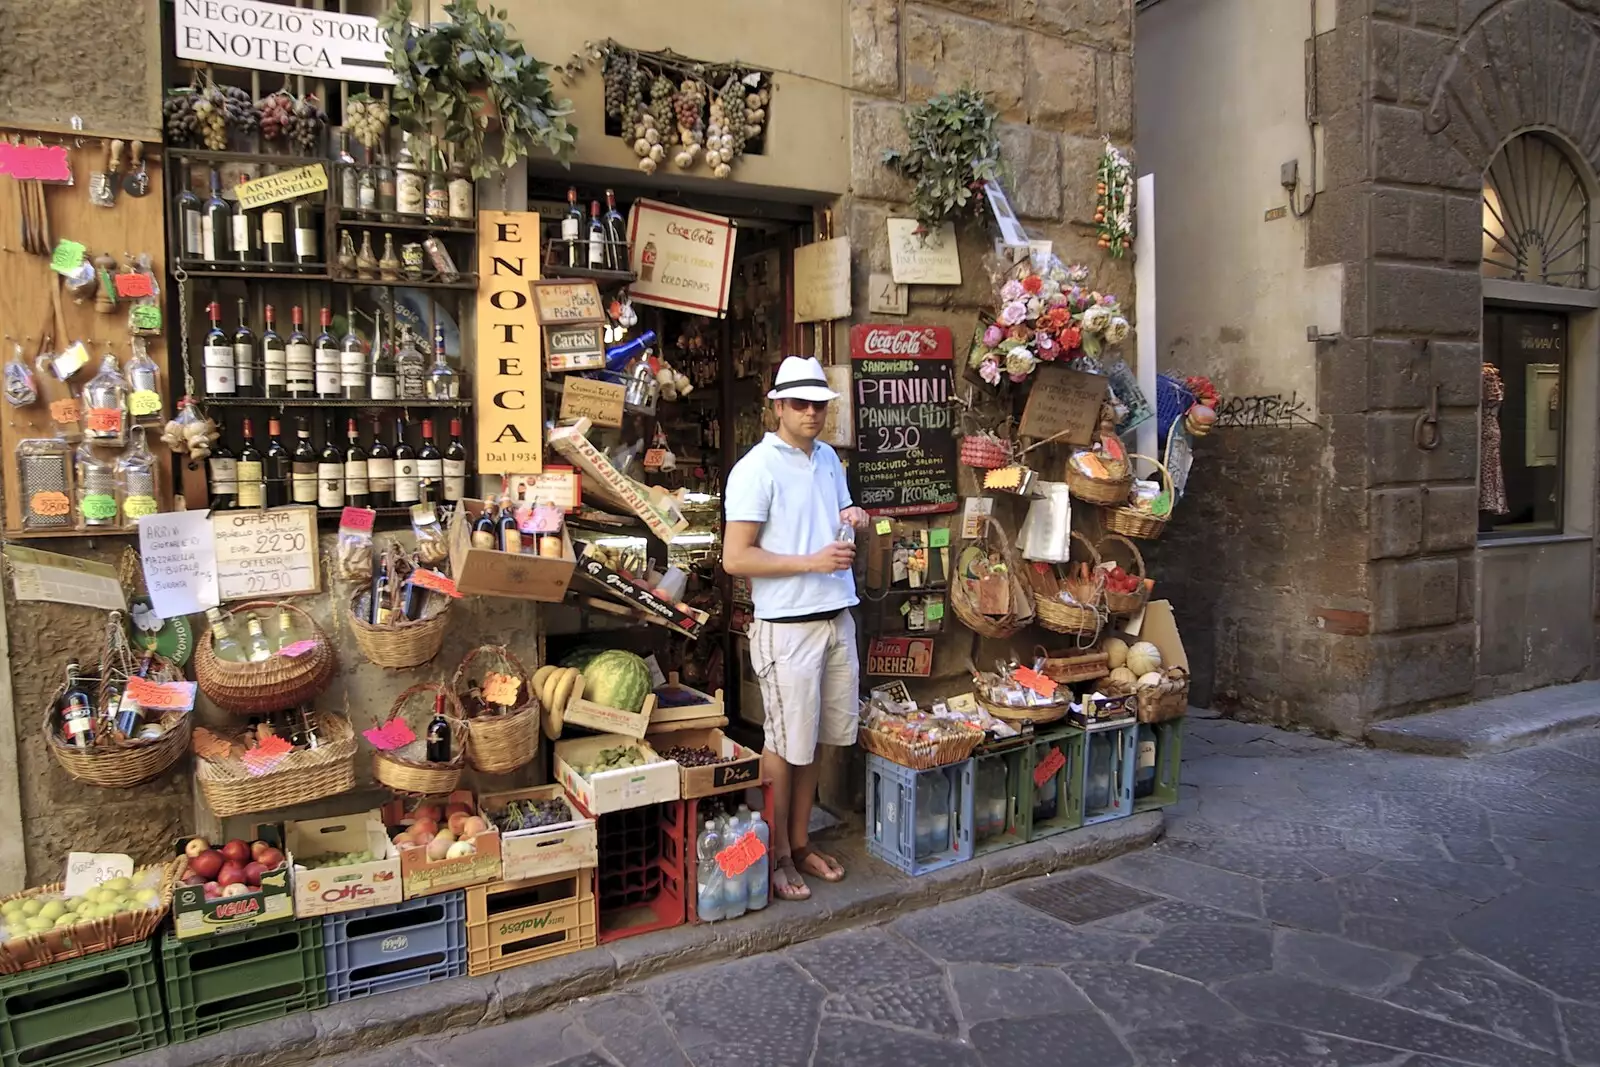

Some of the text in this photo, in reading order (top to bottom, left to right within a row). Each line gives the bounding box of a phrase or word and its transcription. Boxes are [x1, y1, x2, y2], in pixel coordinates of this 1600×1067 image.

[180, 0, 302, 33] NEGOZIO
[183, 25, 335, 70] ENOTECA
[242, 178, 323, 206] TIGNANELLO
[879, 283, 900, 306] 41
[490, 222, 529, 444] ENOTECA
[864, 328, 922, 354] Coca-Cola
[857, 378, 947, 405] PANINI
[486, 450, 537, 463] Dal 1934
[232, 512, 291, 530] OFFERTA
[876, 641, 900, 654] Birra
[869, 656, 914, 673] DREHER
